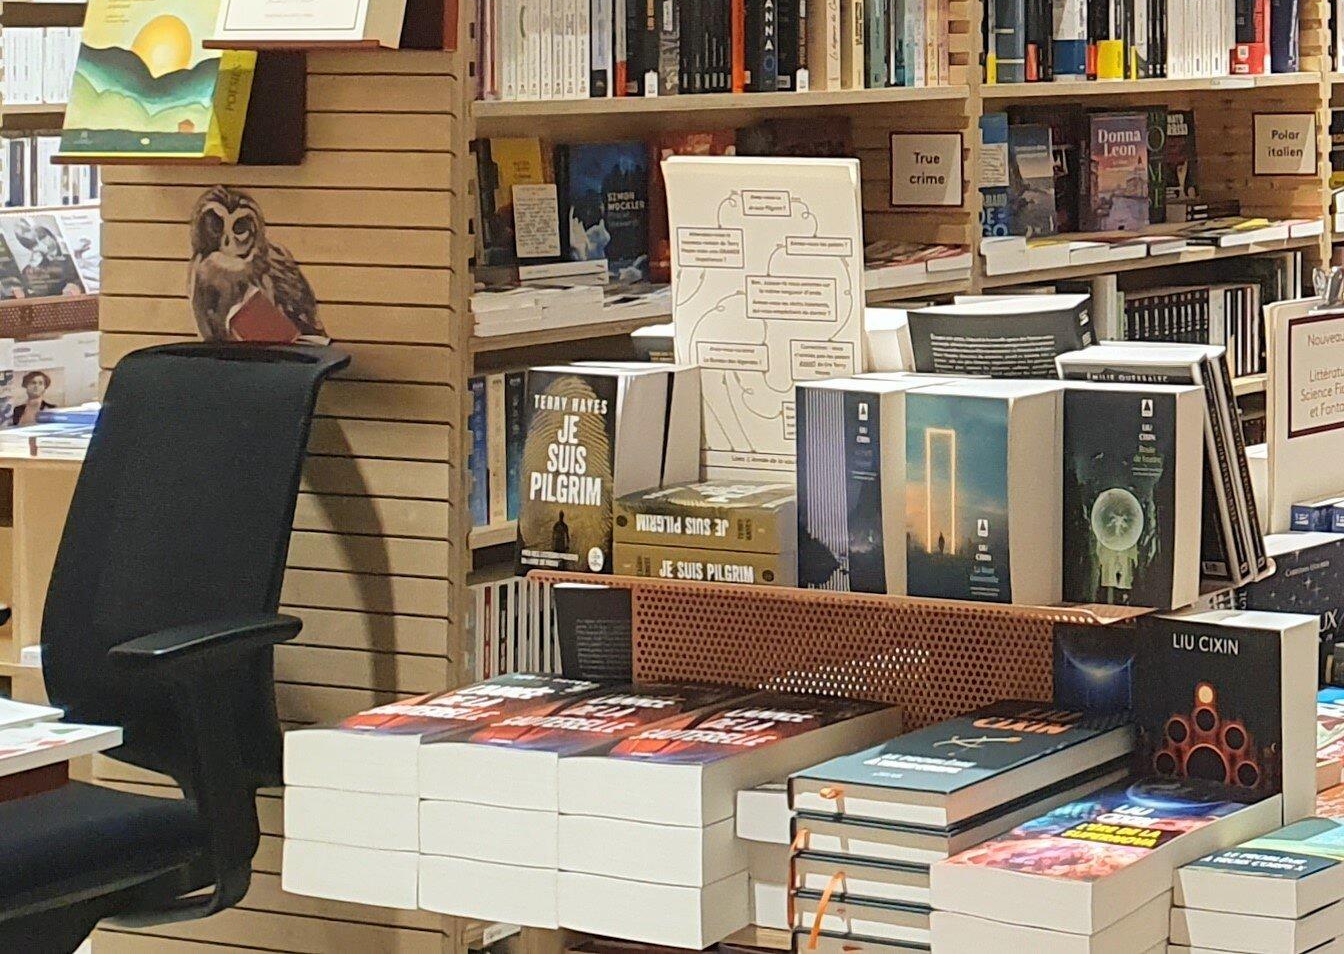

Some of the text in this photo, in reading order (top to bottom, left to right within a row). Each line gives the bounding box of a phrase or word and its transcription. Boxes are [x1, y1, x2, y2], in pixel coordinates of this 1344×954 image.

[1097, 127, 1142, 144] Donna
[1271, 128, 1300, 142] Polar
[1103, 142, 1137, 158] Leon
[1268, 145, 1304, 158] italien
[912, 151, 940, 167] True
[909, 172, 946, 187] crime
[1300, 387, 1333, 402] Science
[533, 394, 608, 415] TERRY HAYES
[1309, 405, 1319, 418] et
[557, 414, 581, 445] JE
[546, 444, 587, 475] SUIS
[529, 471, 602, 507] PILGRIM
[635, 513, 729, 537] JE SUIS PILGRIM
[658, 559, 755, 584] JE SUIS PILGRIM
[1172, 632, 1240, 656] LIU CIXIN
